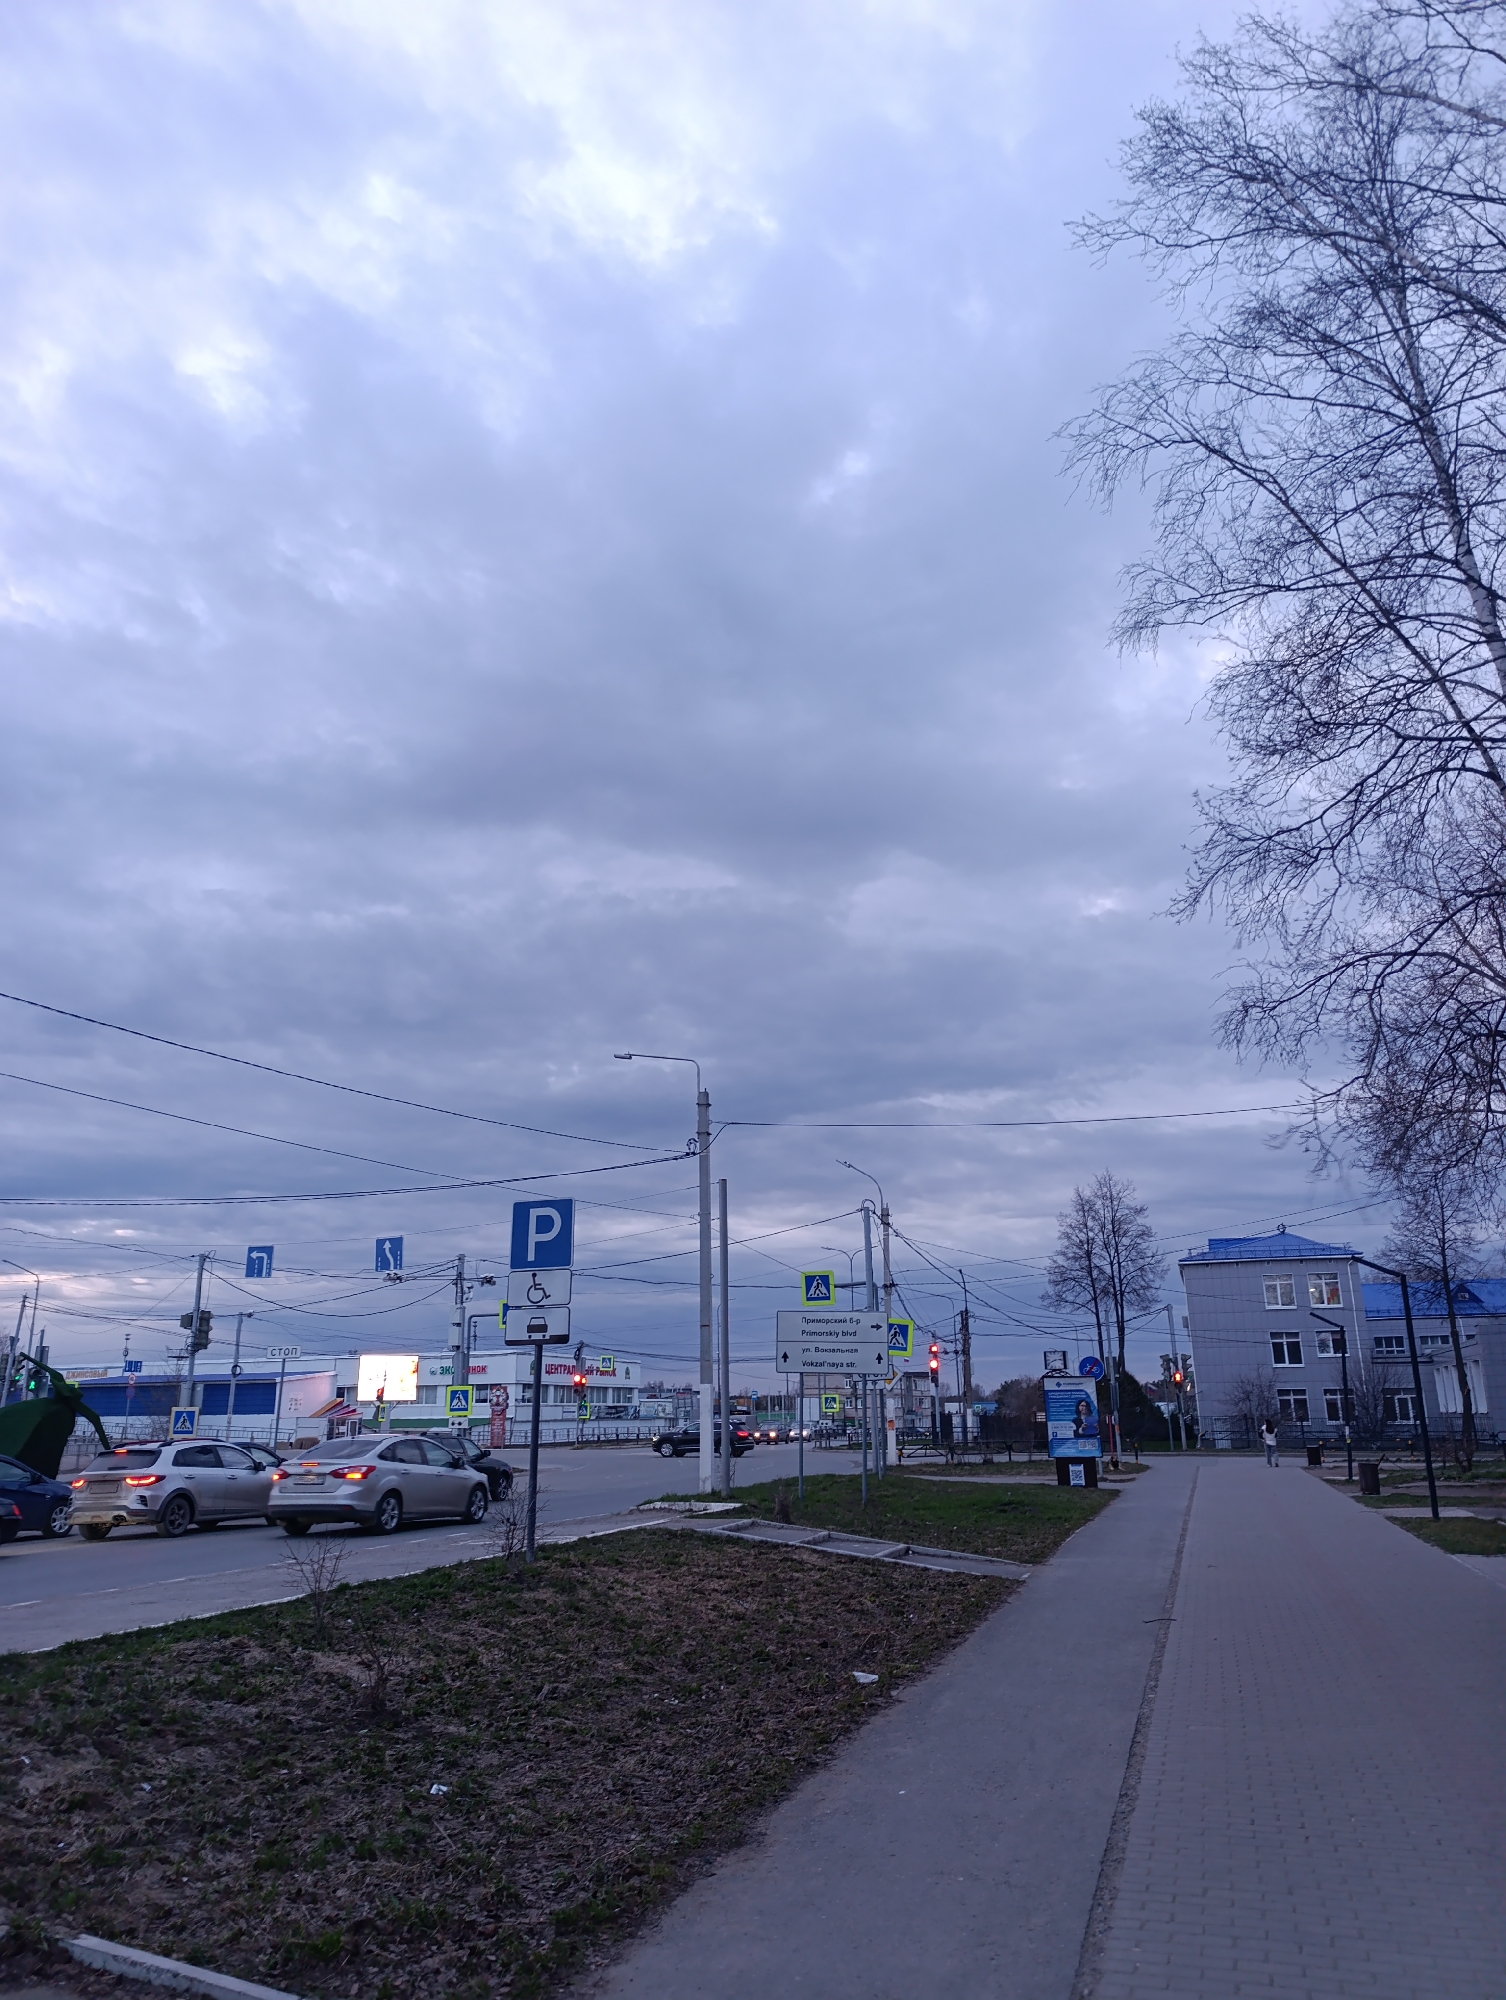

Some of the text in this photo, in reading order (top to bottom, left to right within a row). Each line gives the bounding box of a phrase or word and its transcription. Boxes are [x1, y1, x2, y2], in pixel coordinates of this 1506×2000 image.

[527, 1207, 562, 1262] P
[801, 1316, 861, 1326] Приморский б-р
[801, 1330, 840, 1338] Primorskiy
[270, 1347, 298, 1357] СТОП
[801, 1347, 813, 1355] ул.
[801, 1361, 844, 1369] Vokzal'naya
